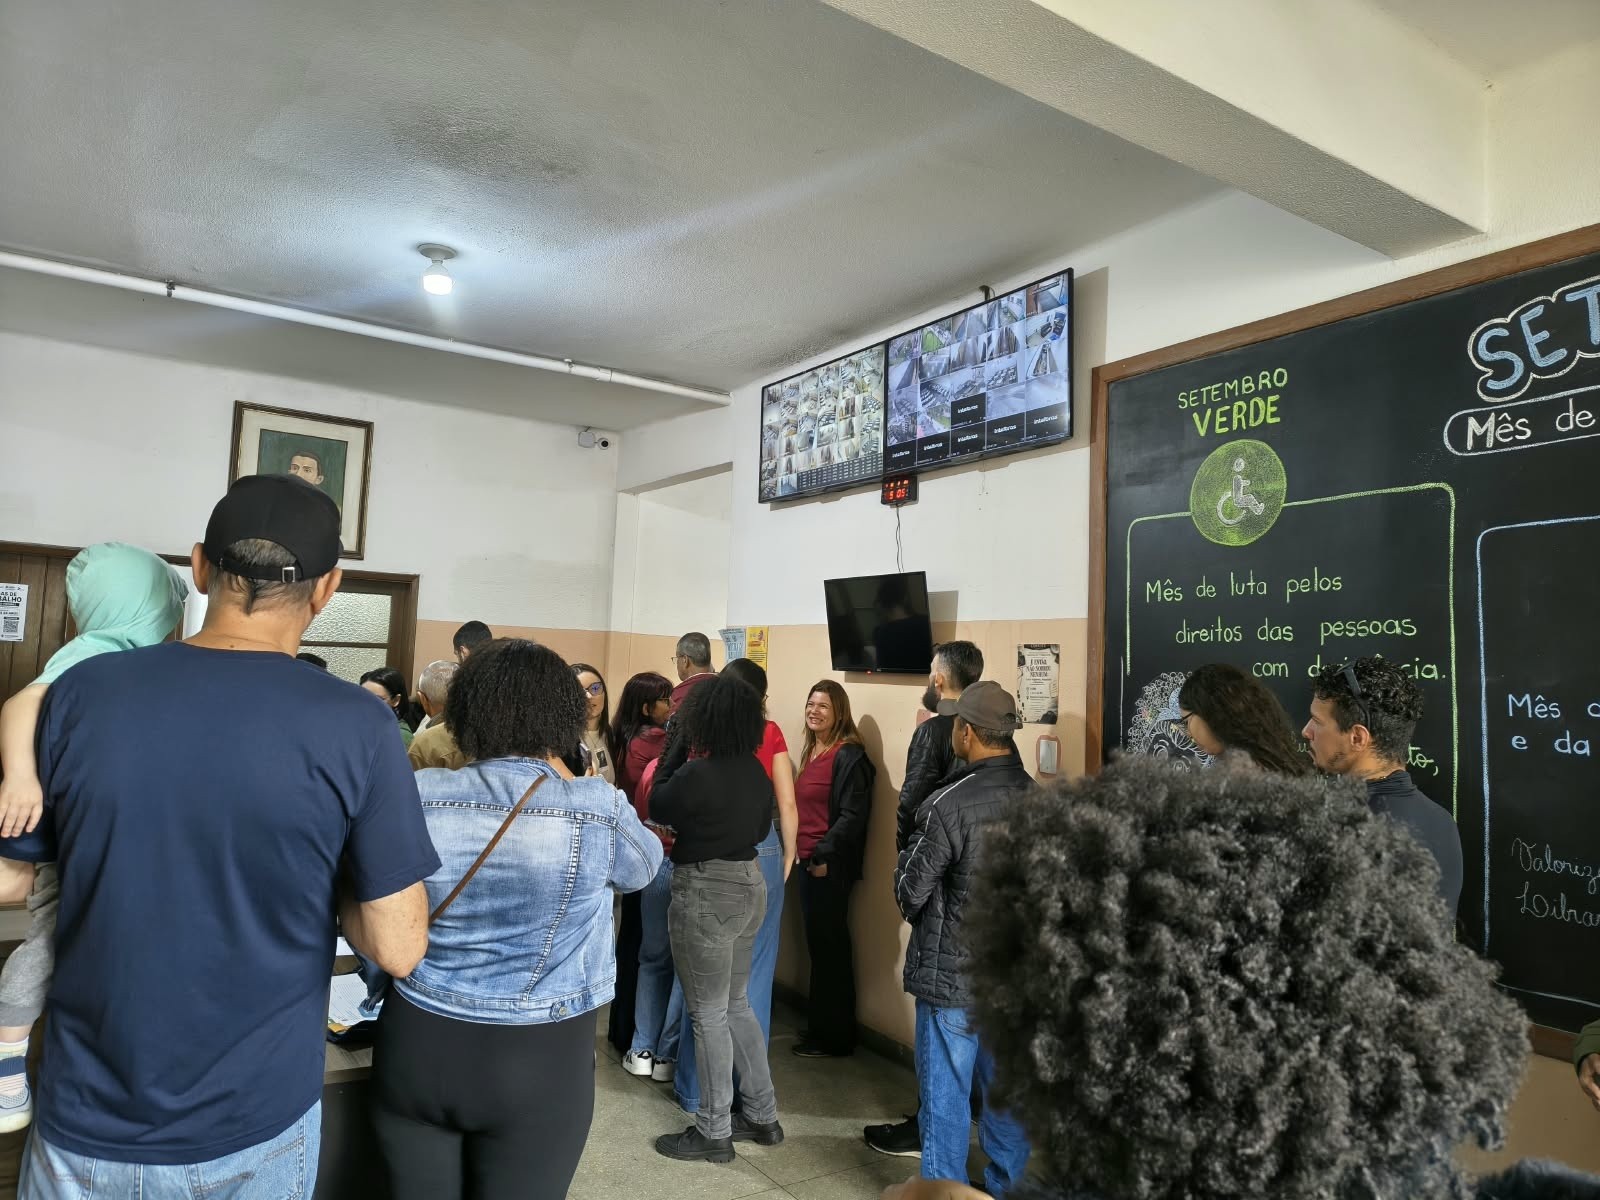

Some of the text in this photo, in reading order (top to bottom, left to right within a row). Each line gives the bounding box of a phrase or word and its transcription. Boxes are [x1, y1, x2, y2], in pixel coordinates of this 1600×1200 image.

[1178, 367, 1288, 409] SETEMBRO
[1192, 395, 1281, 437] VERDE
[1466, 397, 1597, 451] Mês de
[1146, 566, 1343, 604] Mês de luta pelos
[1175, 615, 1418, 646] direitos das pessoas
[1252, 661, 1289, 679] com
[1507, 693, 1561, 719] Mês
[1511, 729, 1591, 757] e da
[1511, 837, 1600, 895] Valoriz
[1514, 880, 1600, 927] Libra
